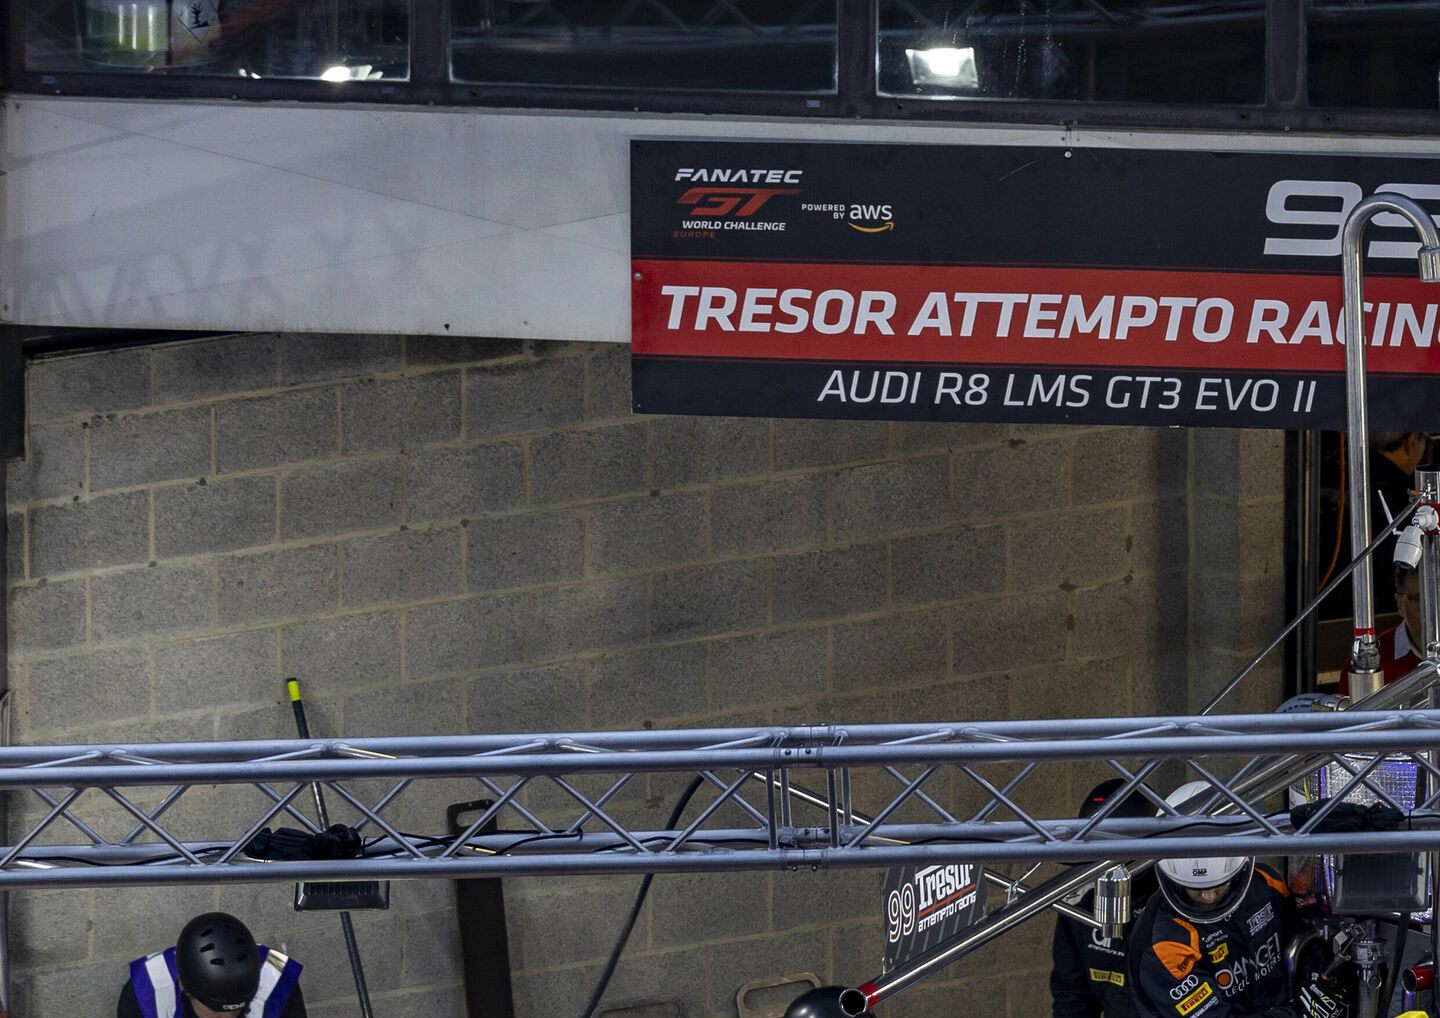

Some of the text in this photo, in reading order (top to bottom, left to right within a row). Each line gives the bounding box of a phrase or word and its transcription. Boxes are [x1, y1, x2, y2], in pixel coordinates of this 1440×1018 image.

[674, 168, 803, 184] FANATEC
[676, 187, 803, 217] GT
[801, 203, 846, 213] POWERED
[833, 211, 845, 220] BY
[849, 204, 893, 221] aws
[682, 220, 787, 231] WORLD CHALLENGE
[673, 230, 716, 239] EUROPE
[661, 285, 898, 336] TRESOR
[907, 292, 1236, 344] ATTEMPTO
[817, 370, 1317, 413] AUDI R8 LMS GT3 EVO II
[915, 864, 974, 912] Tresor
[888, 882, 916, 943] 99
